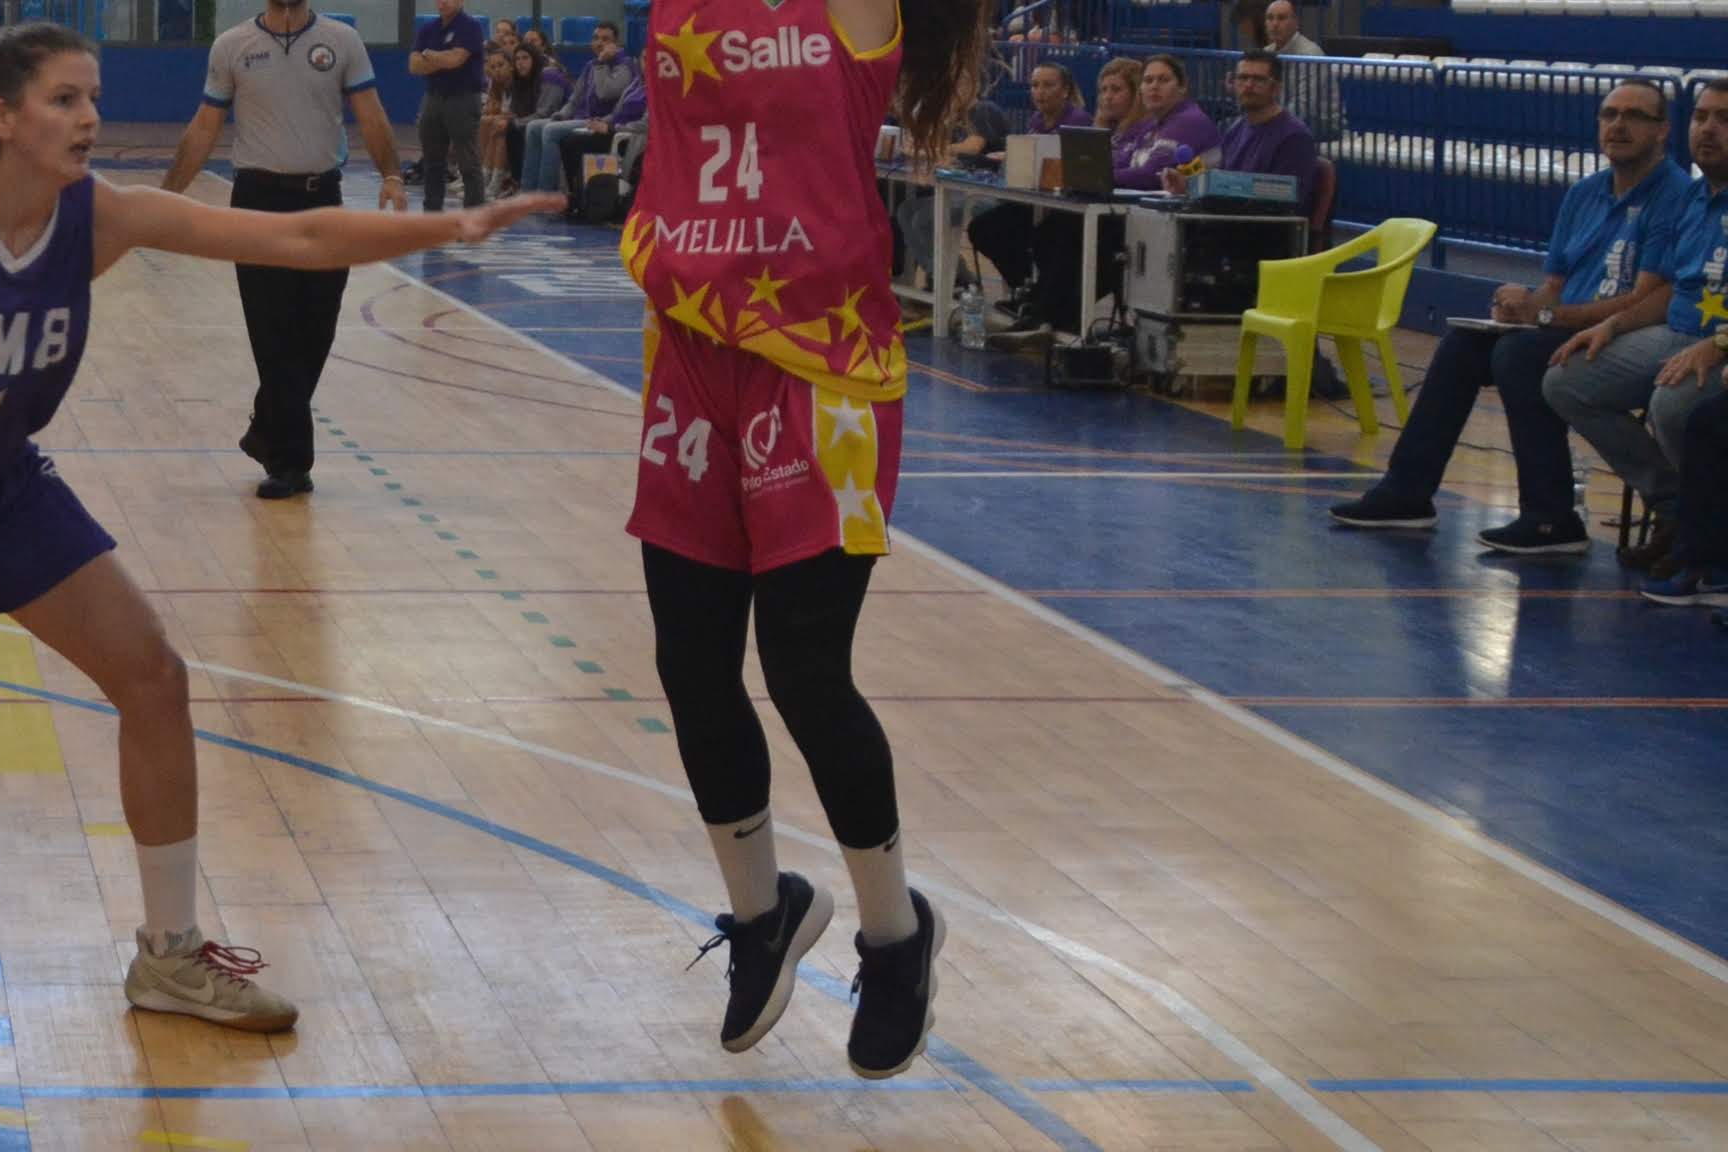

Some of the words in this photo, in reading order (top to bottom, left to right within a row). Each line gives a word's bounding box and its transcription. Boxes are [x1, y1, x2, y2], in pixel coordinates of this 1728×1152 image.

[720, 25, 833, 73] Salle
[697, 121, 764, 204] 24
[654, 215, 816, 255] MELILLA
[641, 393, 713, 483] 24
